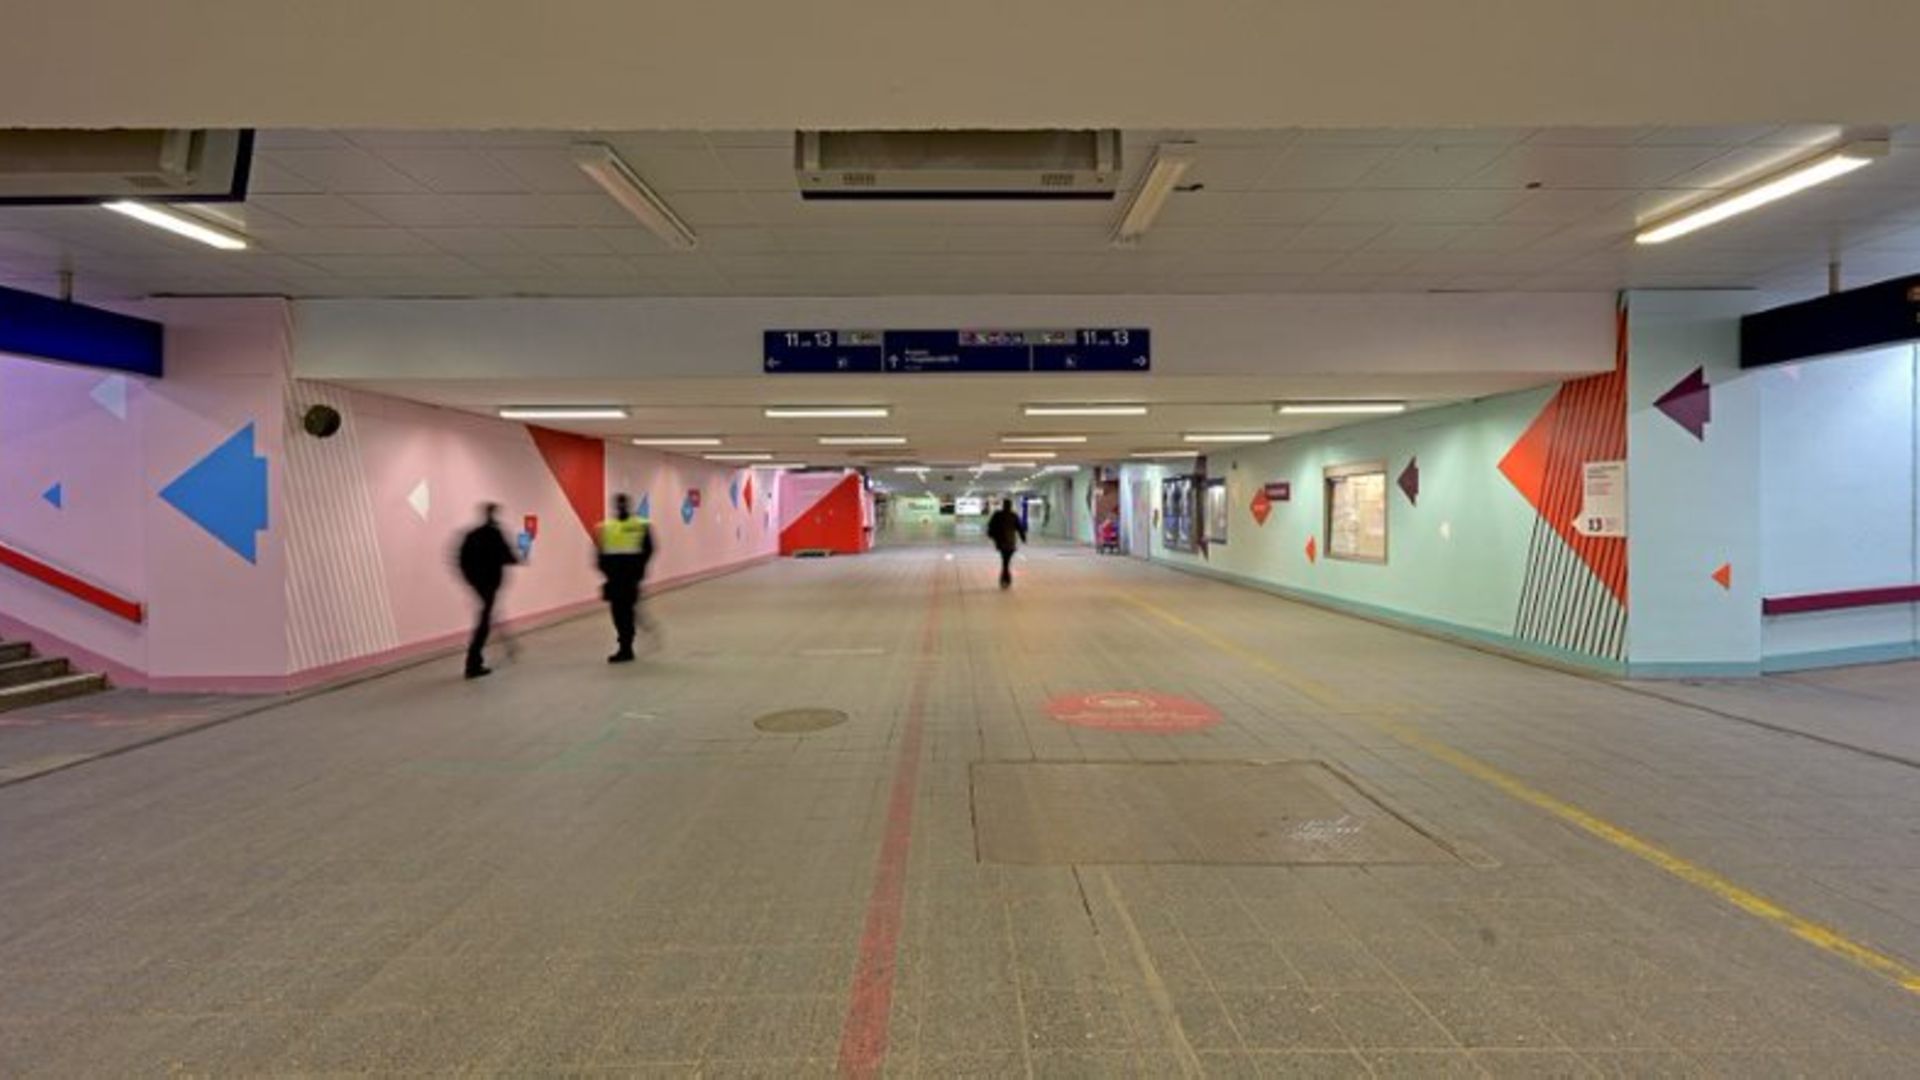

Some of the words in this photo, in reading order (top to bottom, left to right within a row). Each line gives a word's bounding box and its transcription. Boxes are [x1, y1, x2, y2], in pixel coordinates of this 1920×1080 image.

[785, 333, 799, 347] 11
[814, 331, 832, 347] 13
[1083, 330, 1097, 345] 11
[1112, 329, 1129, 346] 13
